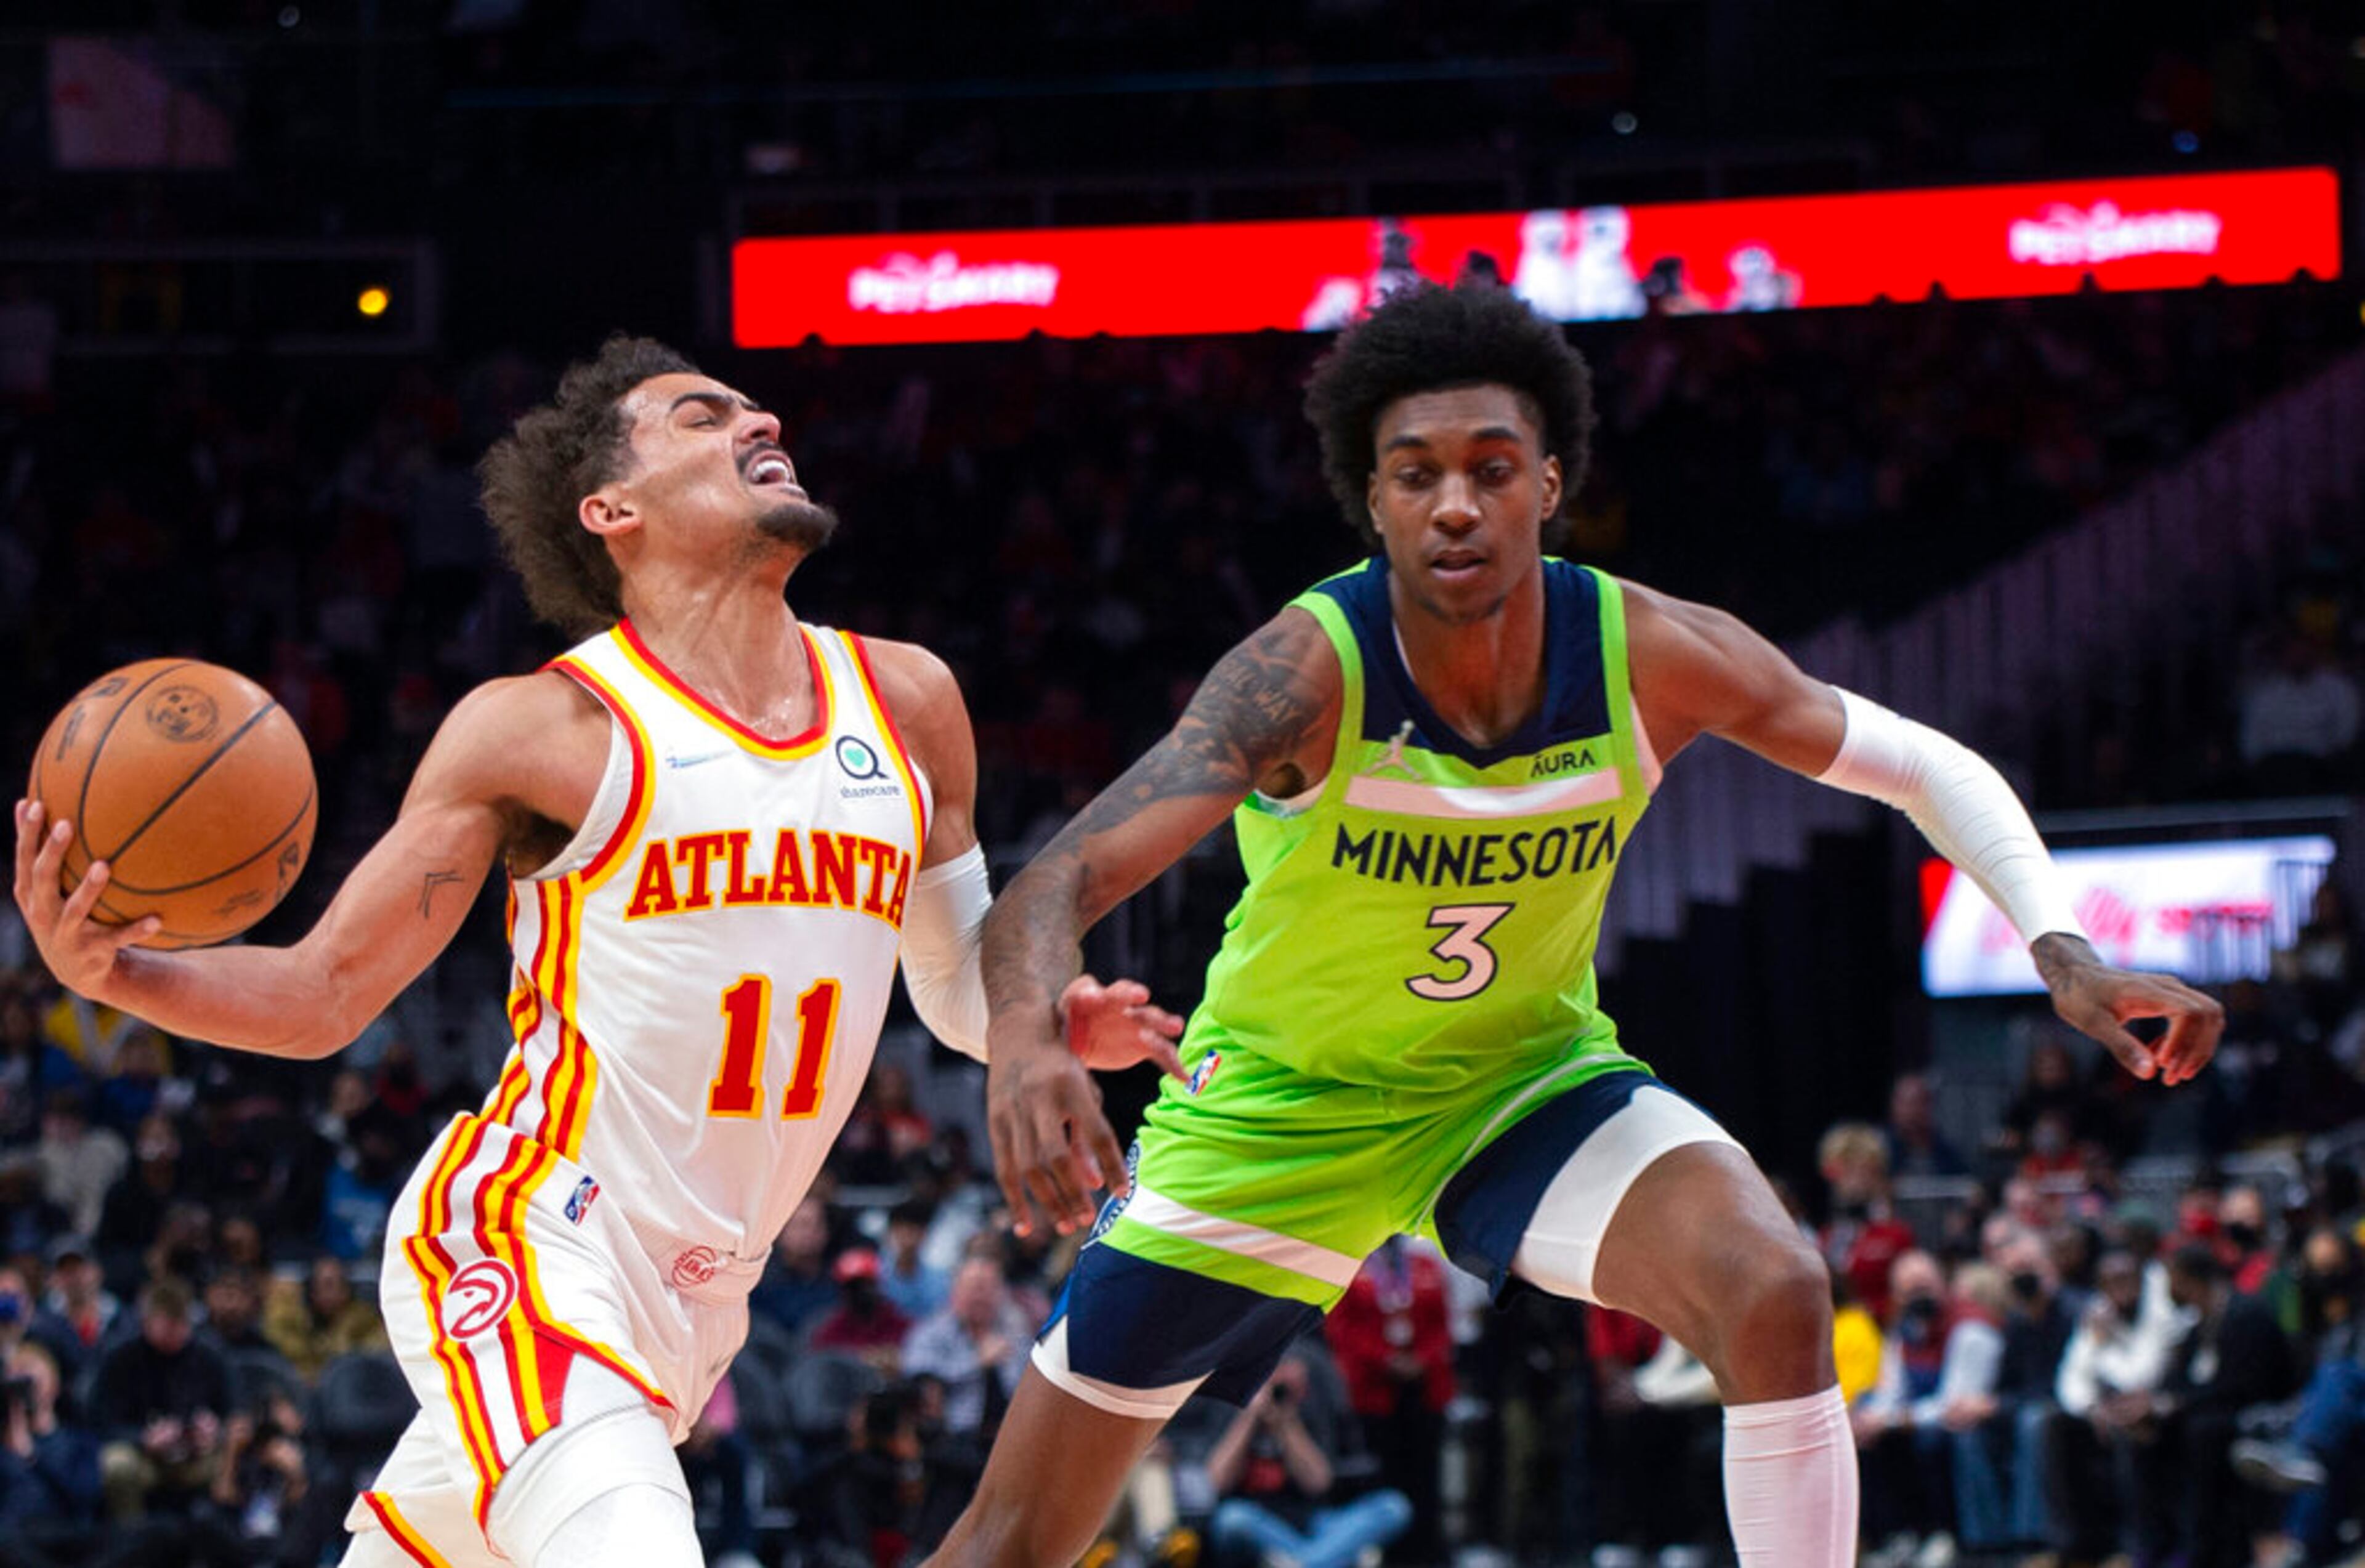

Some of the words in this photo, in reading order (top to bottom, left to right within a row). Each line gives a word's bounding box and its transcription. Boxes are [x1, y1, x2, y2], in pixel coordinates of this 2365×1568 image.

[623, 828, 912, 934] ATLANTA
[1331, 816, 1617, 887] MINNESOTA
[1405, 902, 1516, 1002] 3
[706, 973, 843, 1121] 11
